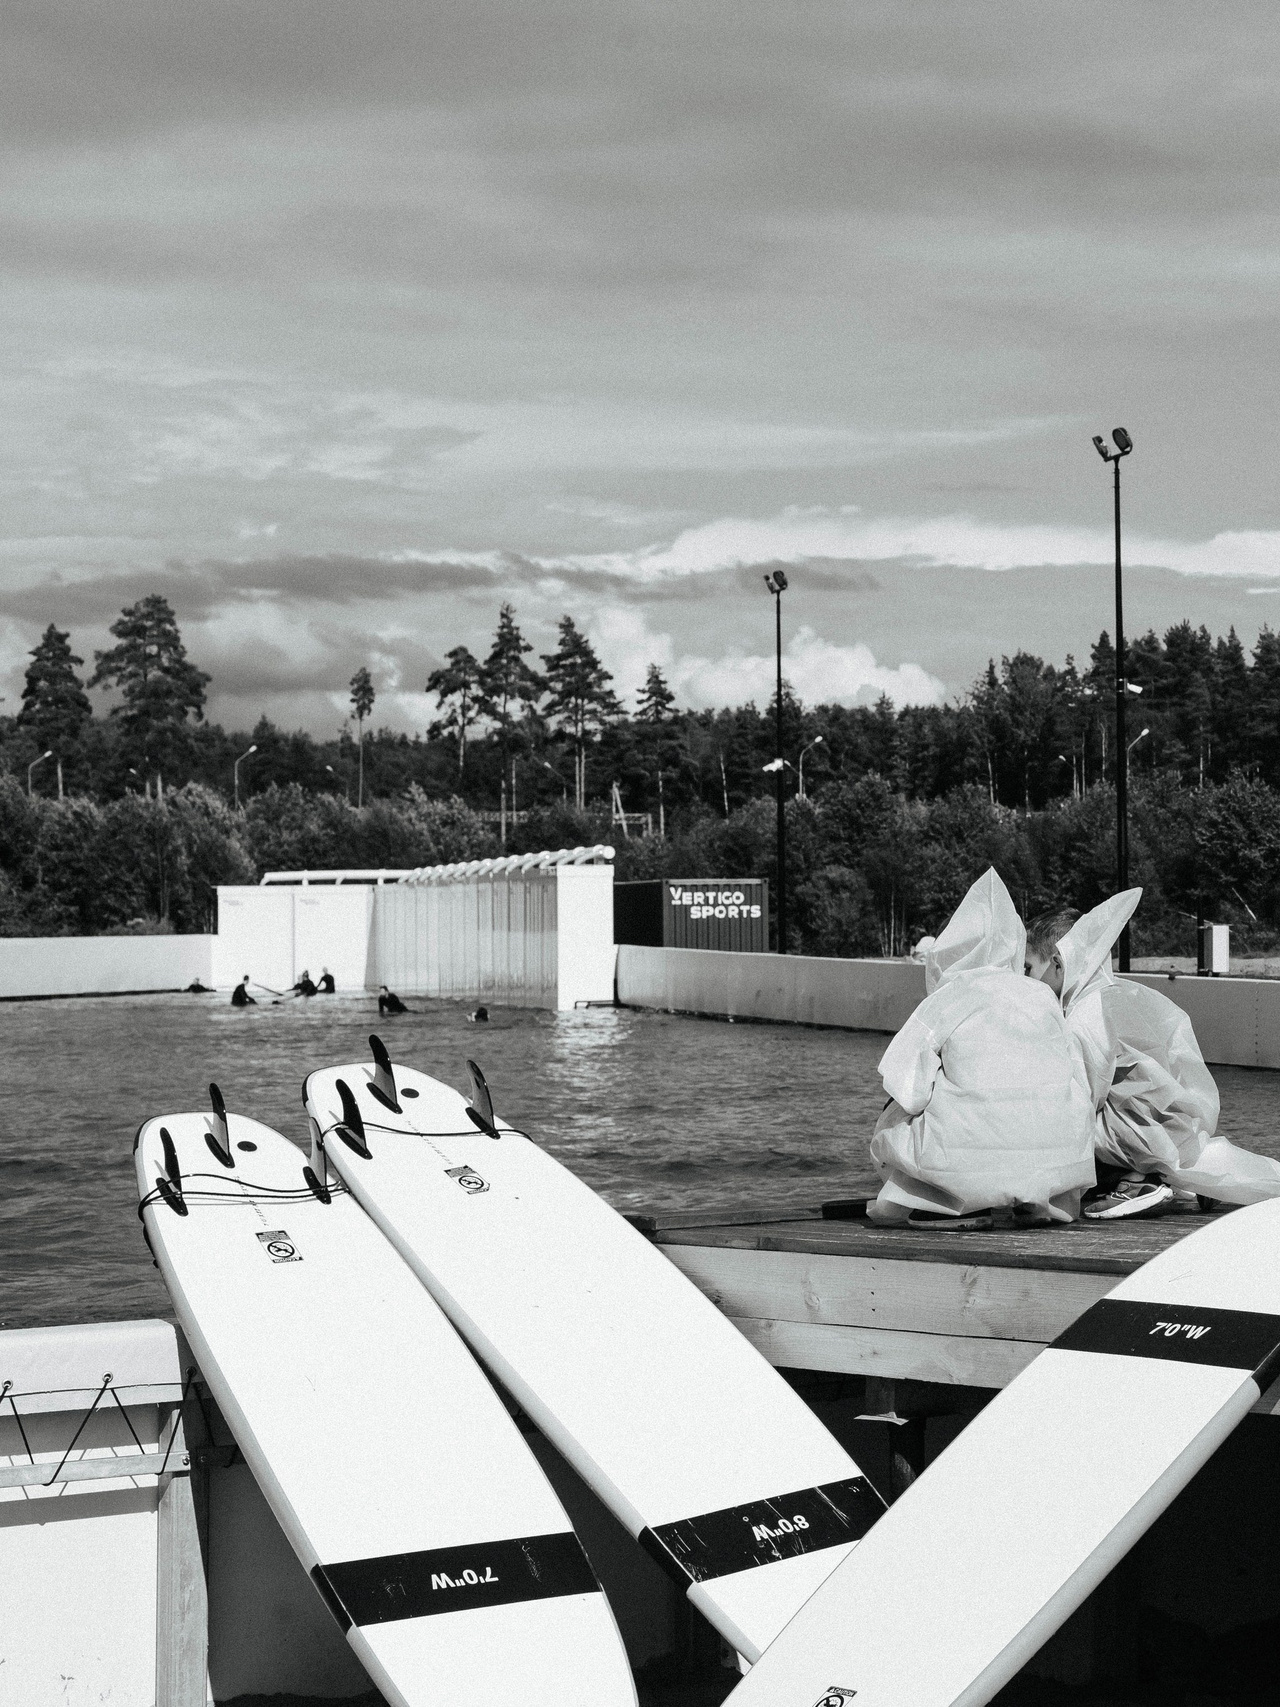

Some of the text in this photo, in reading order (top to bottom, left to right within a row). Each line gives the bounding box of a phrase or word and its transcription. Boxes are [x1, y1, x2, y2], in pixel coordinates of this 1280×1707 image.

[669, 886, 745, 905] VERTIGO
[690, 905, 762, 919] SPORTS
[1149, 1322, 1211, 1339] 7'0"W
[431, 1566, 499, 1590] 7'0"W
